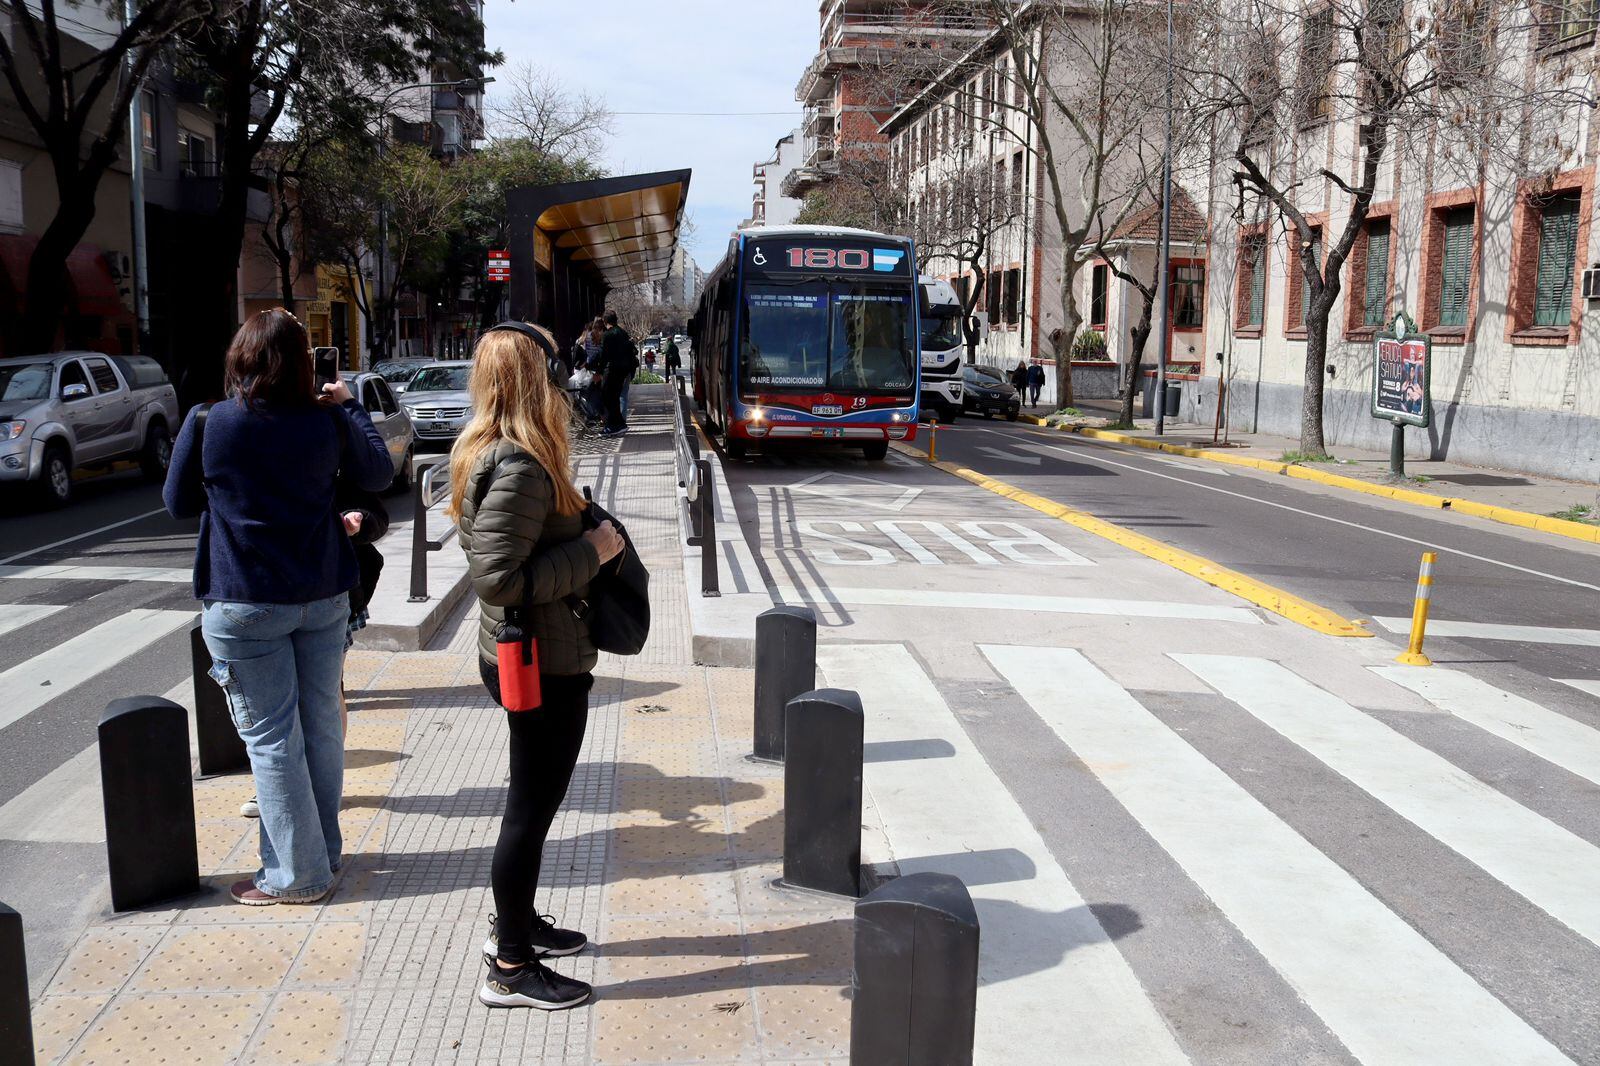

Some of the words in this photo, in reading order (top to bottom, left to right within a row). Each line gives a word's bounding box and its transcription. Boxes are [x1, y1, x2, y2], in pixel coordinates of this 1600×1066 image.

[786, 247, 870, 269] 180
[757, 376, 770, 384] AIRE
[771, 376, 818, 385] ACONDICIONADO
[1396, 381, 1401, 392] 8
[851, 397, 866, 406] 19
[796, 519, 1099, 566] BUS
